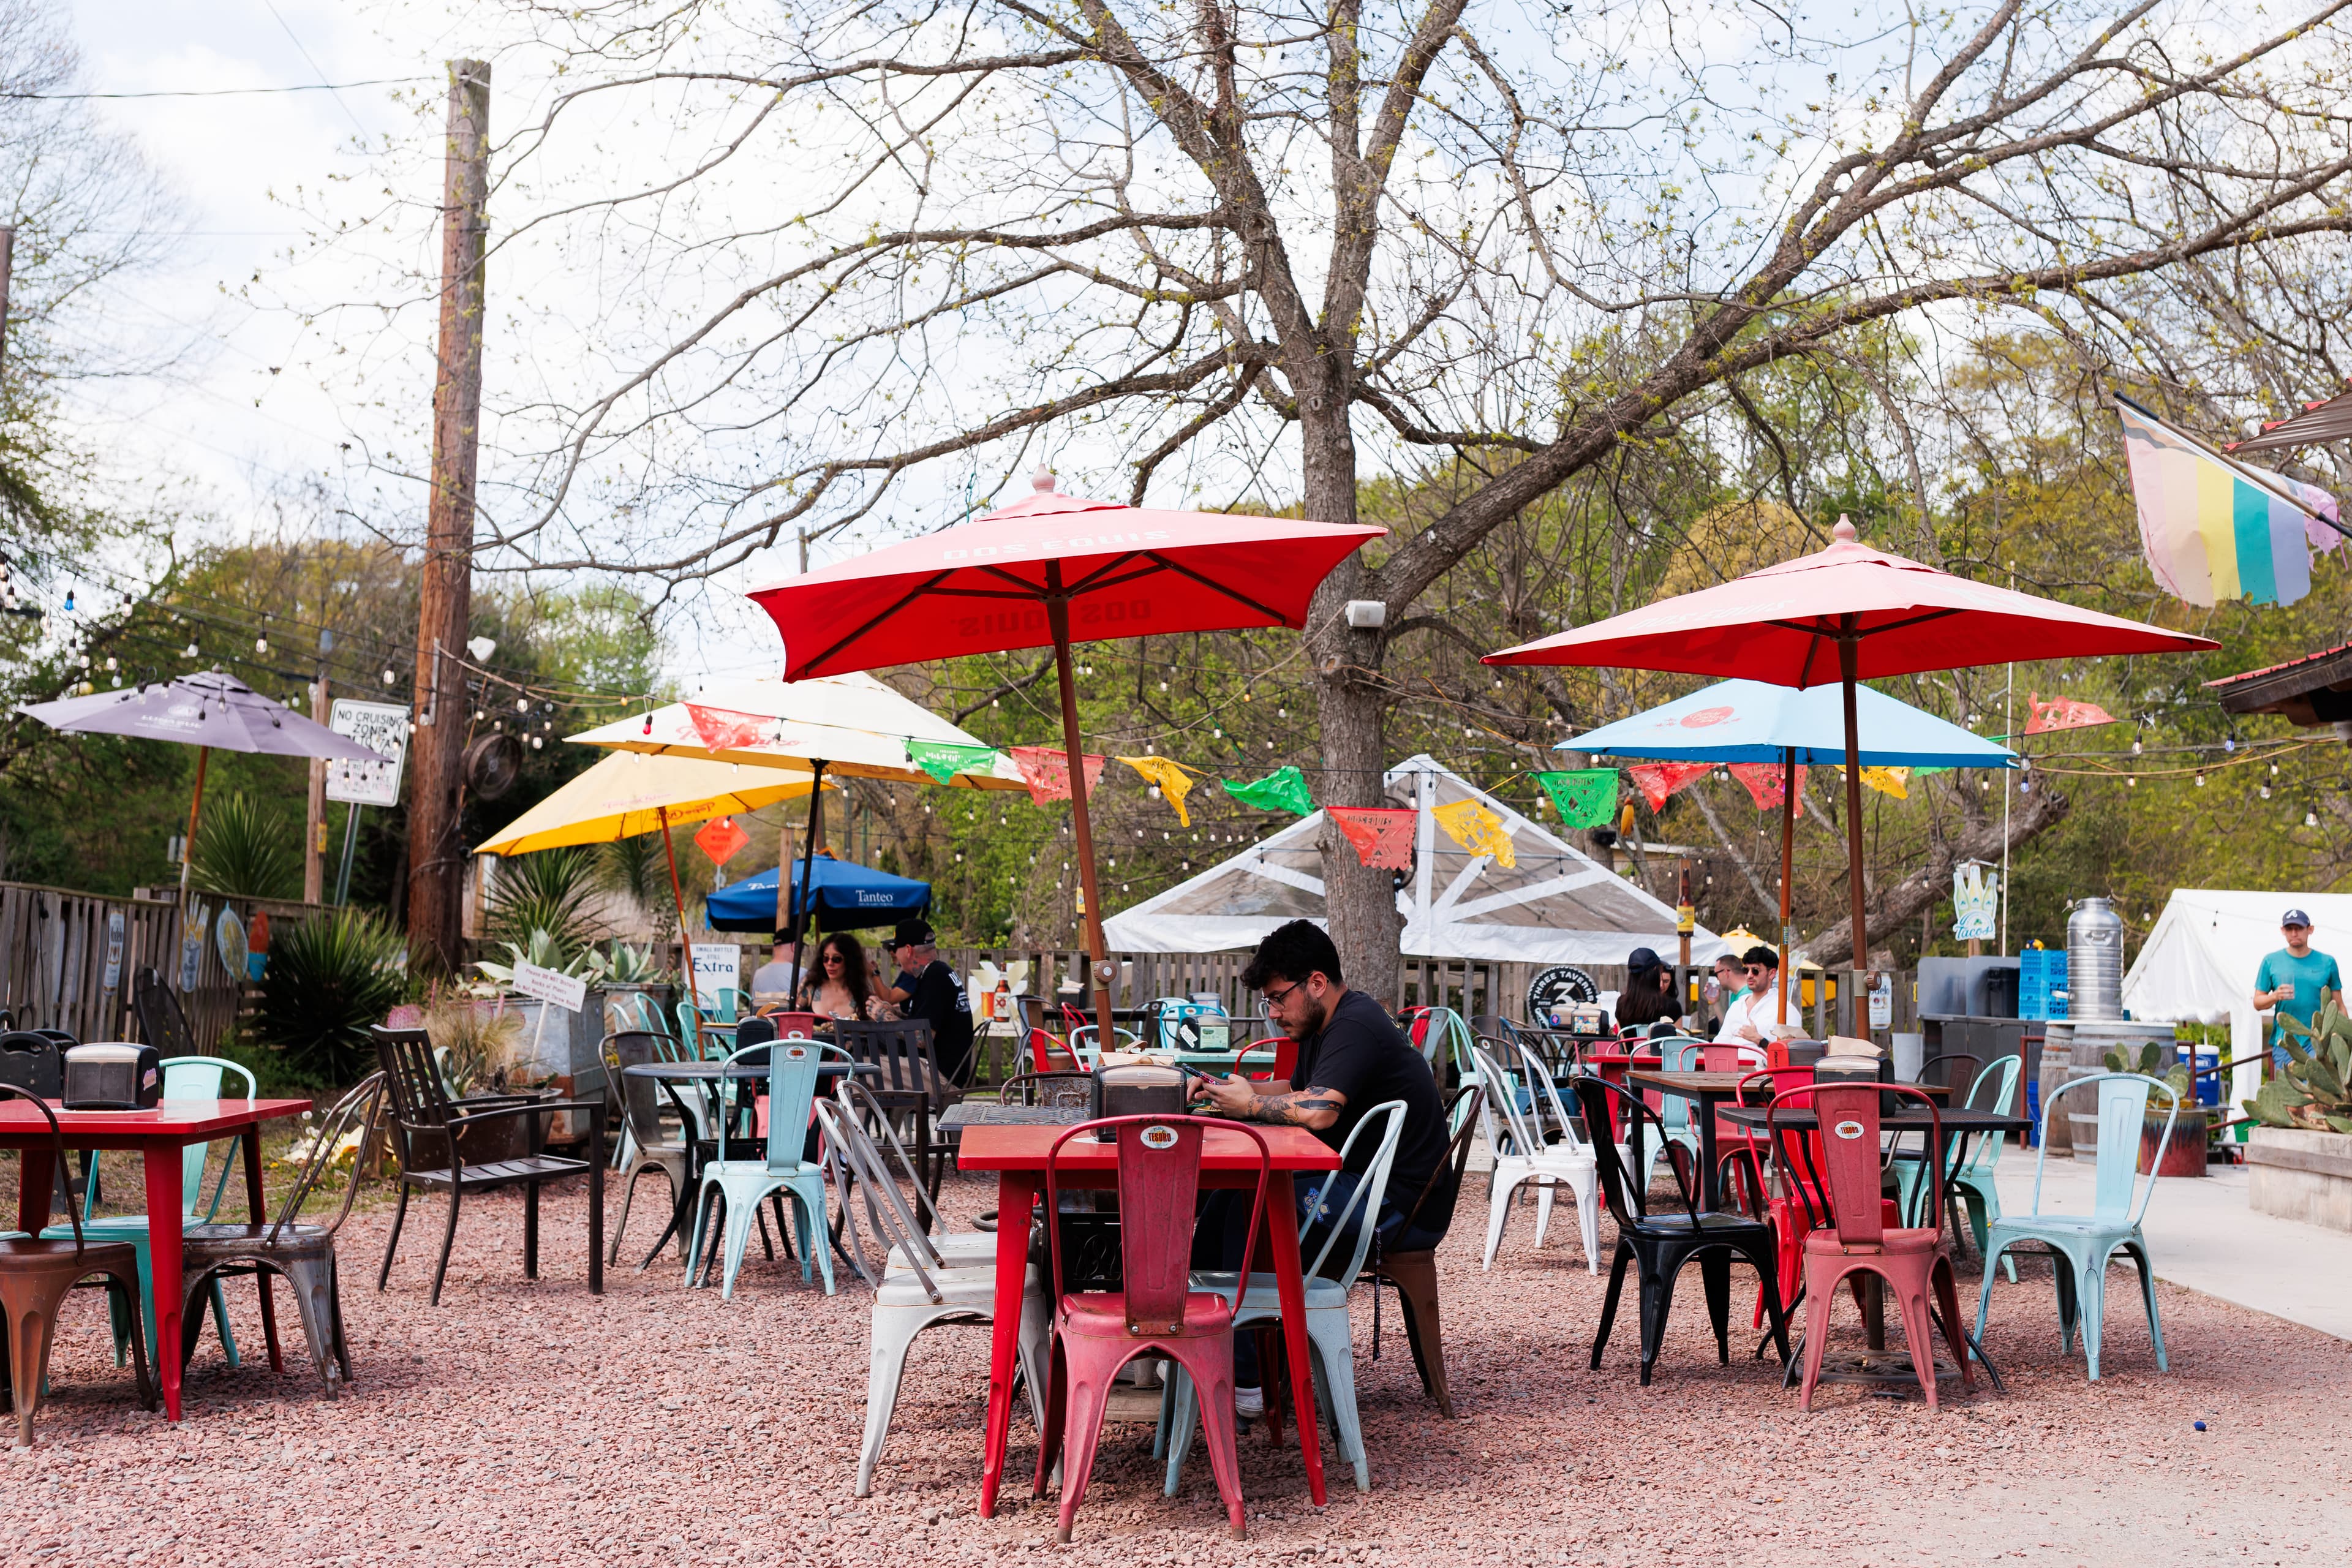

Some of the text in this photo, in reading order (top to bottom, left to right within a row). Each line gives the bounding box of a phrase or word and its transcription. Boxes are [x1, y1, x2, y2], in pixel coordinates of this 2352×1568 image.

[943, 530, 1171, 560] DOS EQUIS
[337, 709, 404, 726] NO CRUISING
[856, 889, 894, 902] Tanteo
[2286, 910, 2298, 919] A
[1954, 925, 1991, 939] Tacos
[693, 957, 733, 973] Extra
[1533, 971, 1594, 1001] THREE TAVERNS
[1869, 984, 1890, 995] odelo
[1148, 1133, 1172, 1142] TESORO
